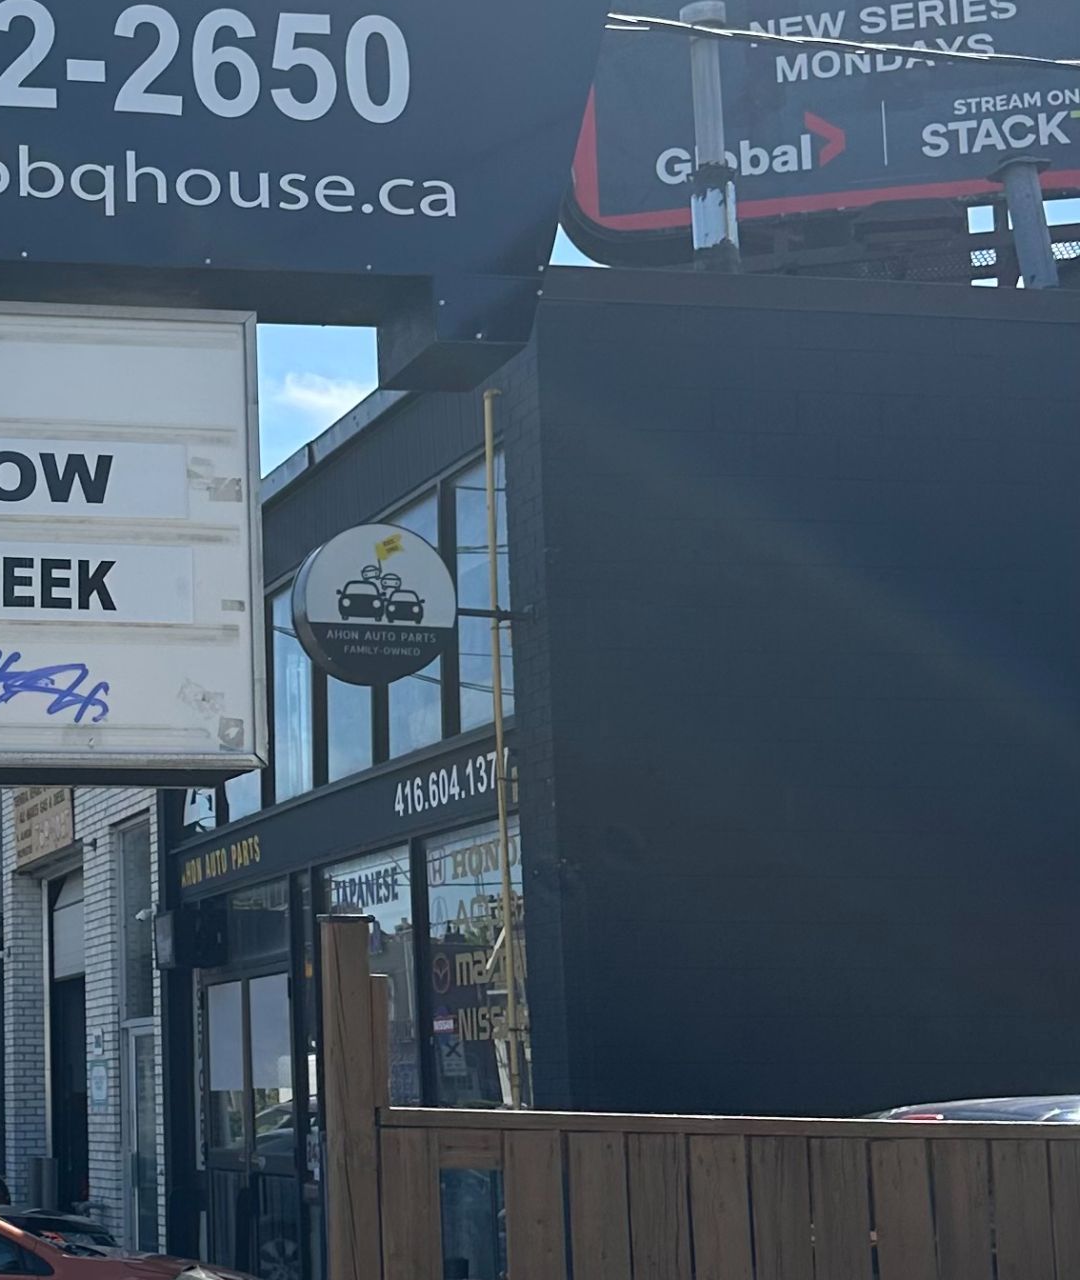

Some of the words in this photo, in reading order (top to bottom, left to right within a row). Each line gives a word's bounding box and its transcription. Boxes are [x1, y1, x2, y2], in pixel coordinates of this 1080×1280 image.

[748, 9, 846, 48] NEW
[953, 93, 1042, 115] STREAM
[1046, 87, 1080, 106] ON
[655, 133, 813, 185] Gbal
[326, 628, 359, 640] AHON
[364, 630, 396, 641] AUTO
[400, 631, 437, 643] PARTS
[230, 834, 261, 871] PARTS
[334, 865, 399, 908] JAPANESE
